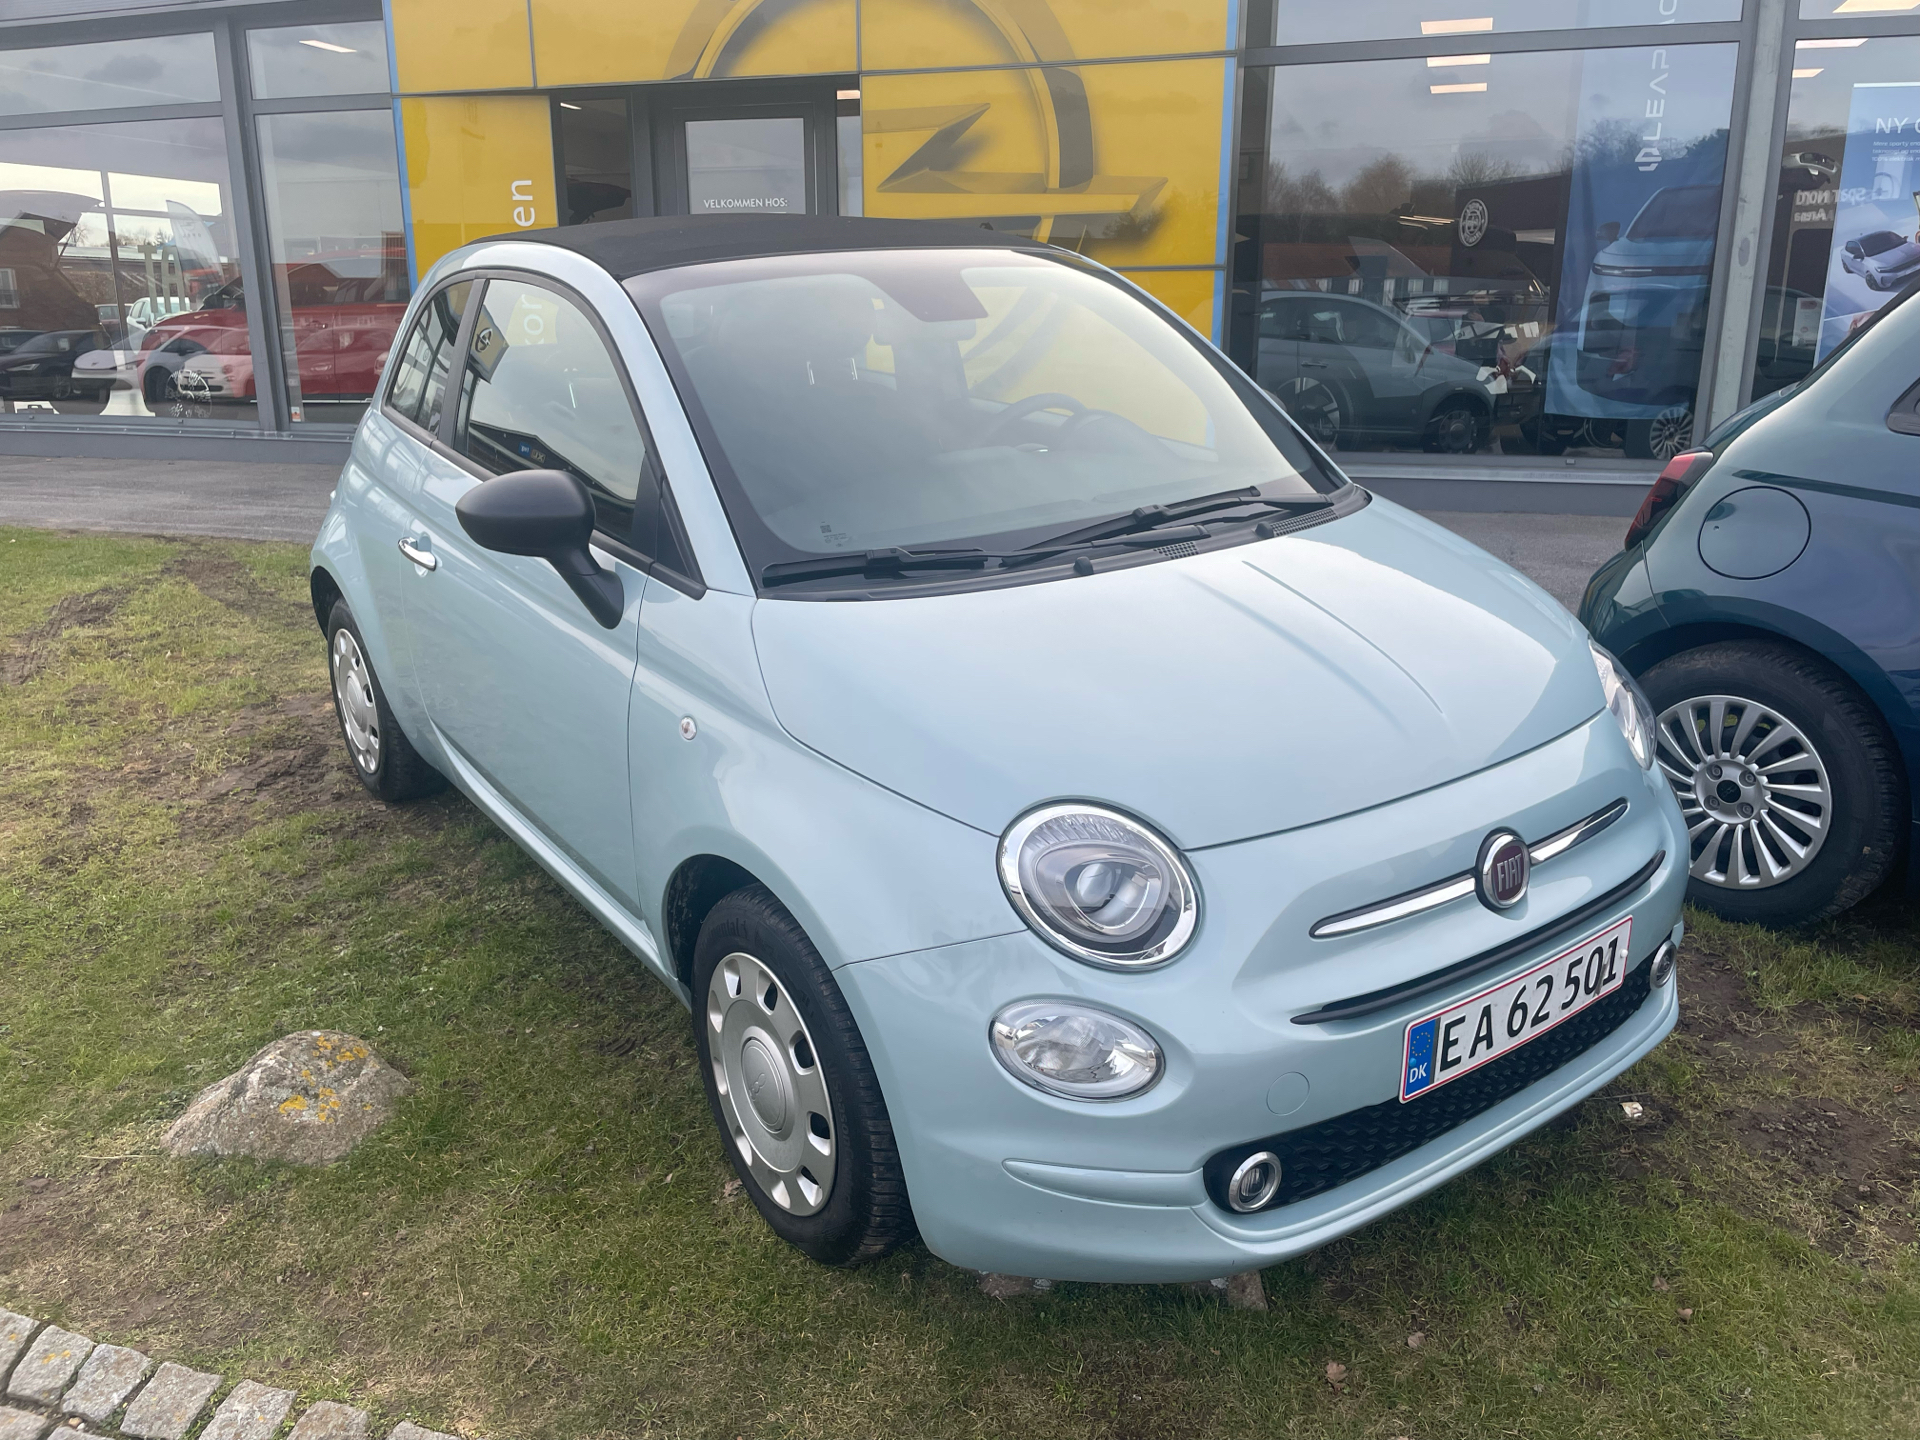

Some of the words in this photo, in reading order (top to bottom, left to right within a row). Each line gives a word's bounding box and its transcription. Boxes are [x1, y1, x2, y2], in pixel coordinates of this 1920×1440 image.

[1875, 117, 1910, 134] NY
[703, 198, 763, 209] VELKOMMEN
[765, 197, 788, 207] HOS:
[1496, 853, 1522, 893] FIAT
[1439, 1003, 1494, 1073] EA
[1507, 974, 1554, 1038] 62
[1561, 936, 1619, 1011] 501
[1409, 1062, 1427, 1084] DK
